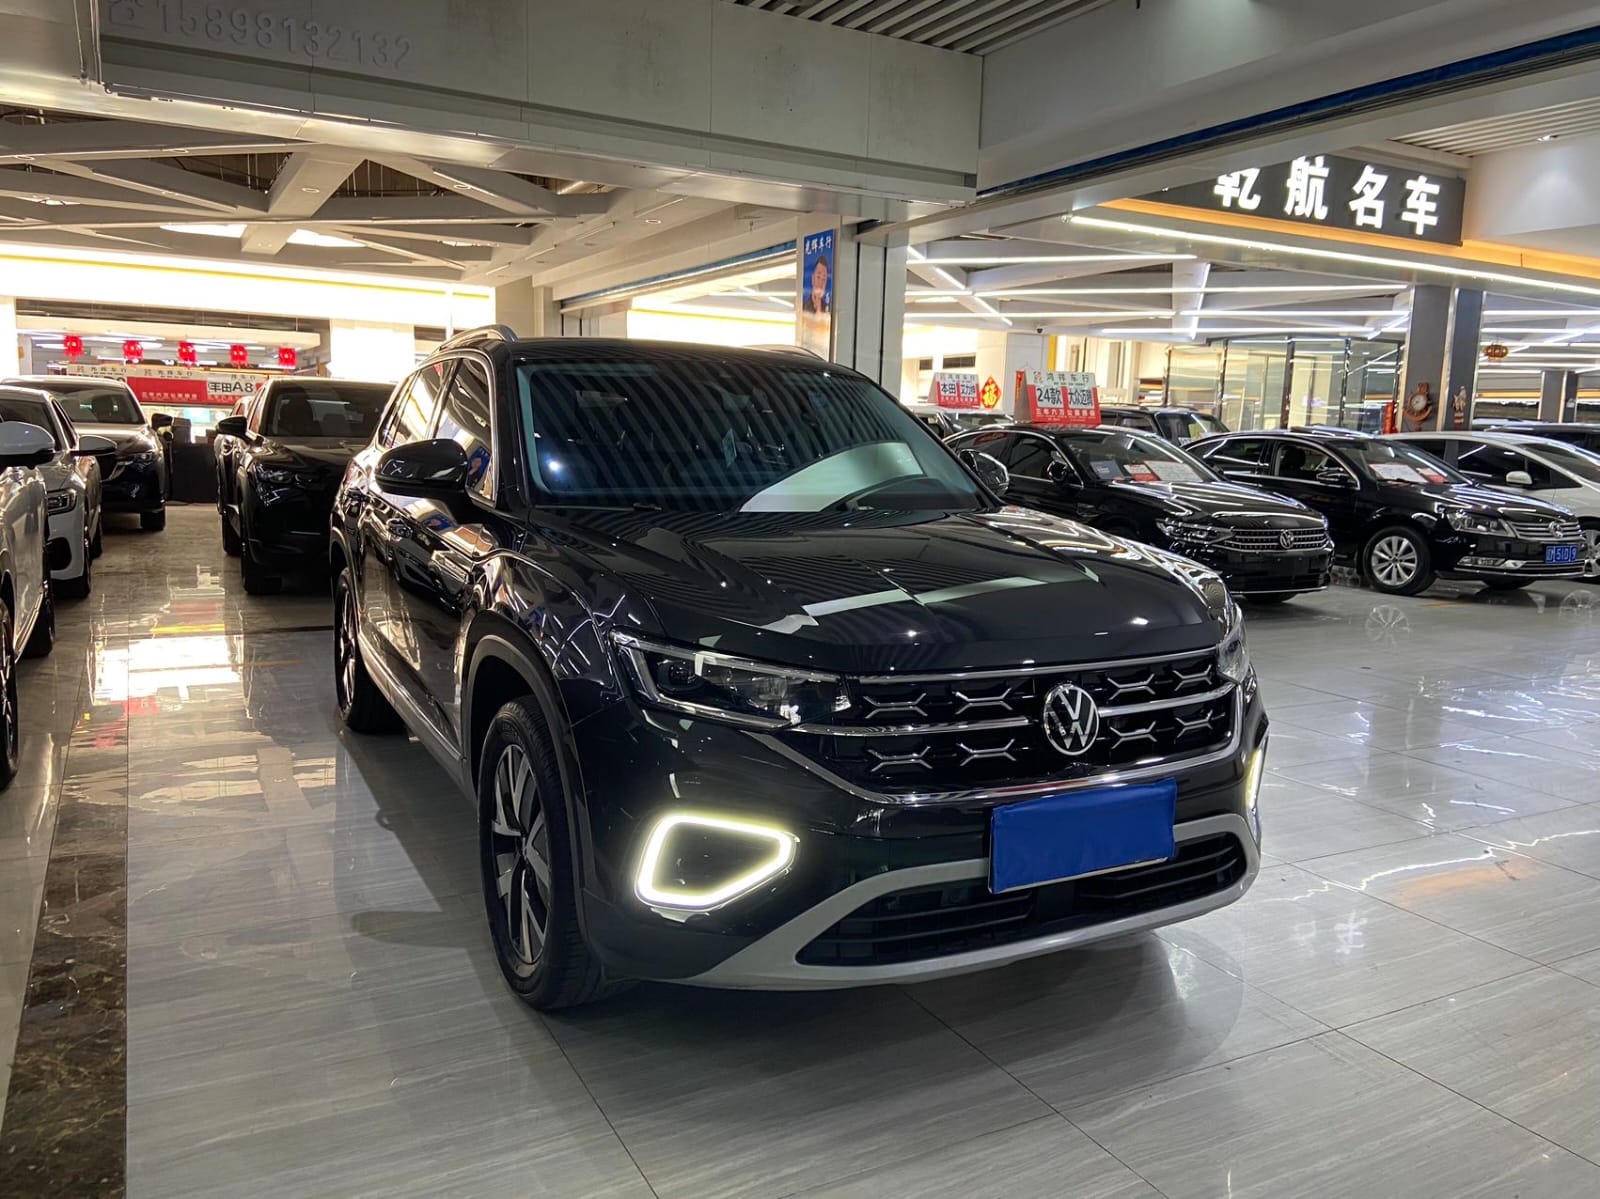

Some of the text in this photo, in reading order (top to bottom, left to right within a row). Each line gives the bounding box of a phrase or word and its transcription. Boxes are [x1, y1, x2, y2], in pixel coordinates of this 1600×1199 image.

[157, 0, 411, 69] 15898132132
[1213, 155, 1441, 236] 乾航名车
[941, 383, 956, 394] 本田
[1037, 387, 1063, 405] 24款
